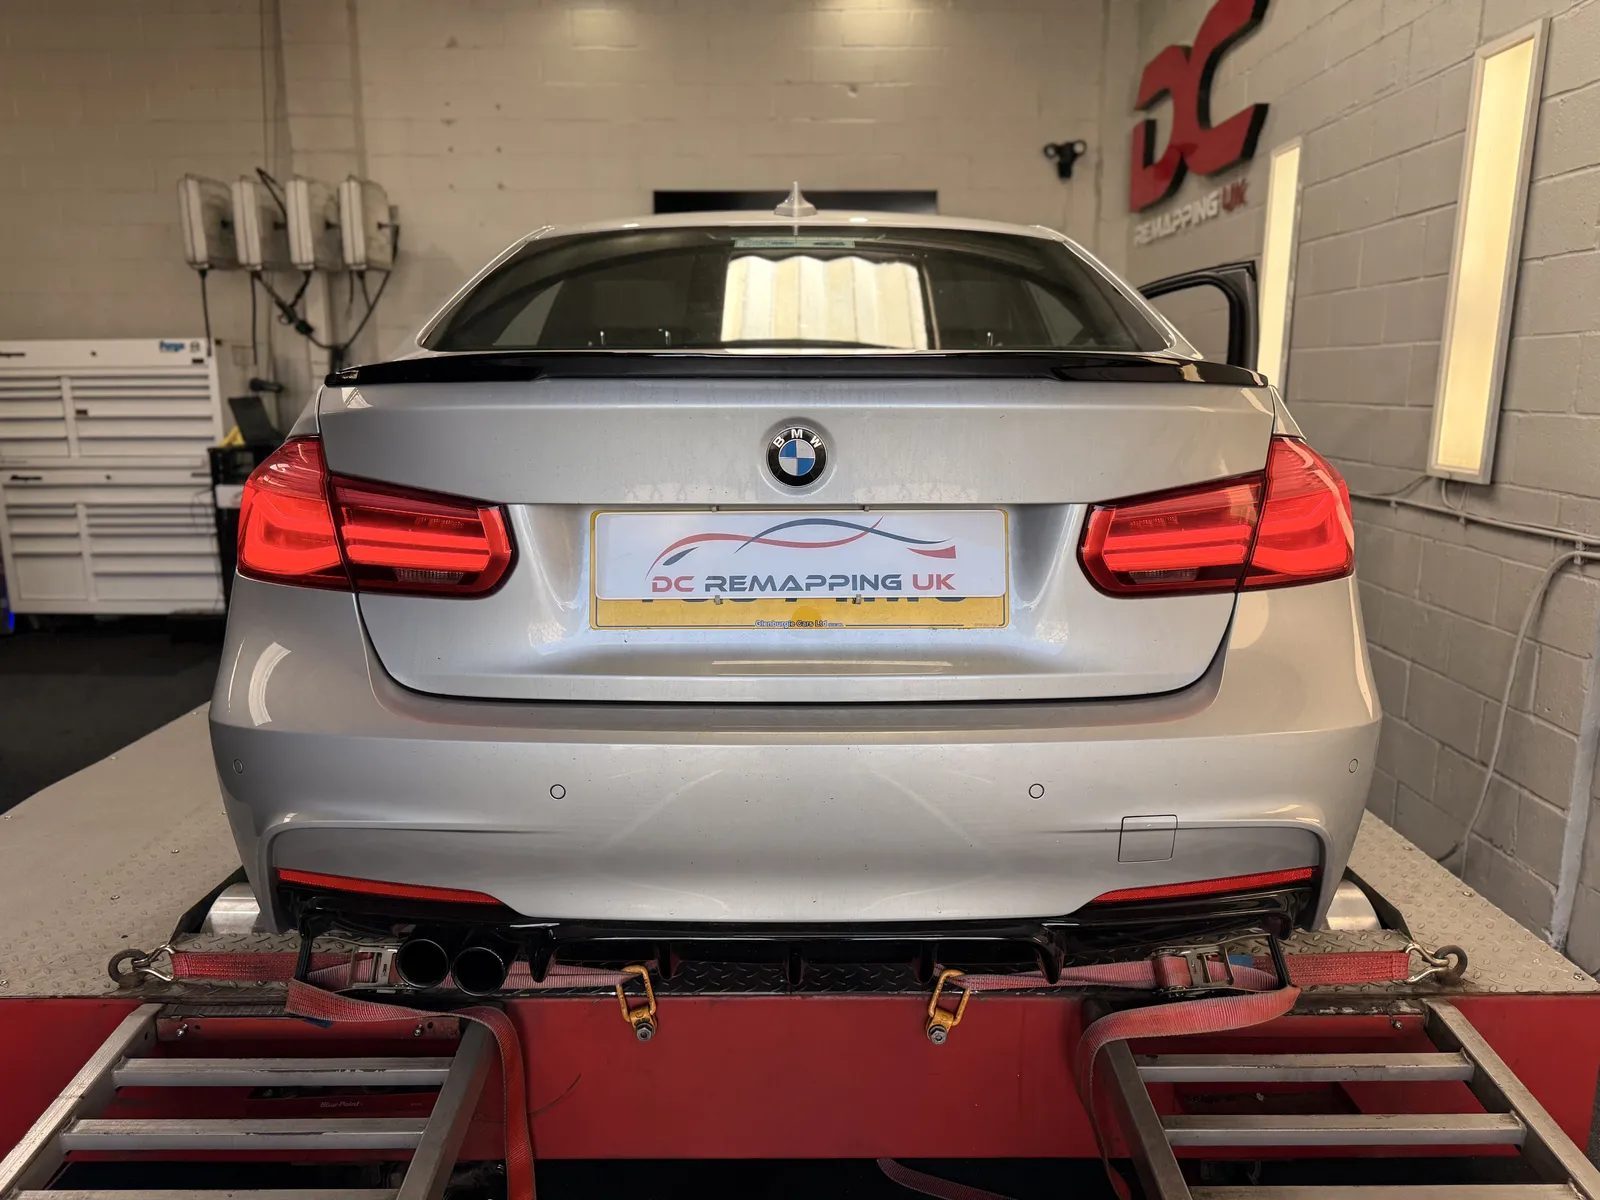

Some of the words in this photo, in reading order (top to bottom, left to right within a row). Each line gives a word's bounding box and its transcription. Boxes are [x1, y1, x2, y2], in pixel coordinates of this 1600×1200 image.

[1129, 0, 1269, 212] DC
[1134, 190, 1219, 246] REMAPPING
[1222, 178, 1248, 212] UK
[773, 428, 822, 448] BMW
[652, 575, 695, 593] DC
[705, 573, 902, 592] REMAPPING
[913, 573, 956, 591] UK
[796, 620, 814, 628] Cars
[815, 620, 828, 628] Ltd
